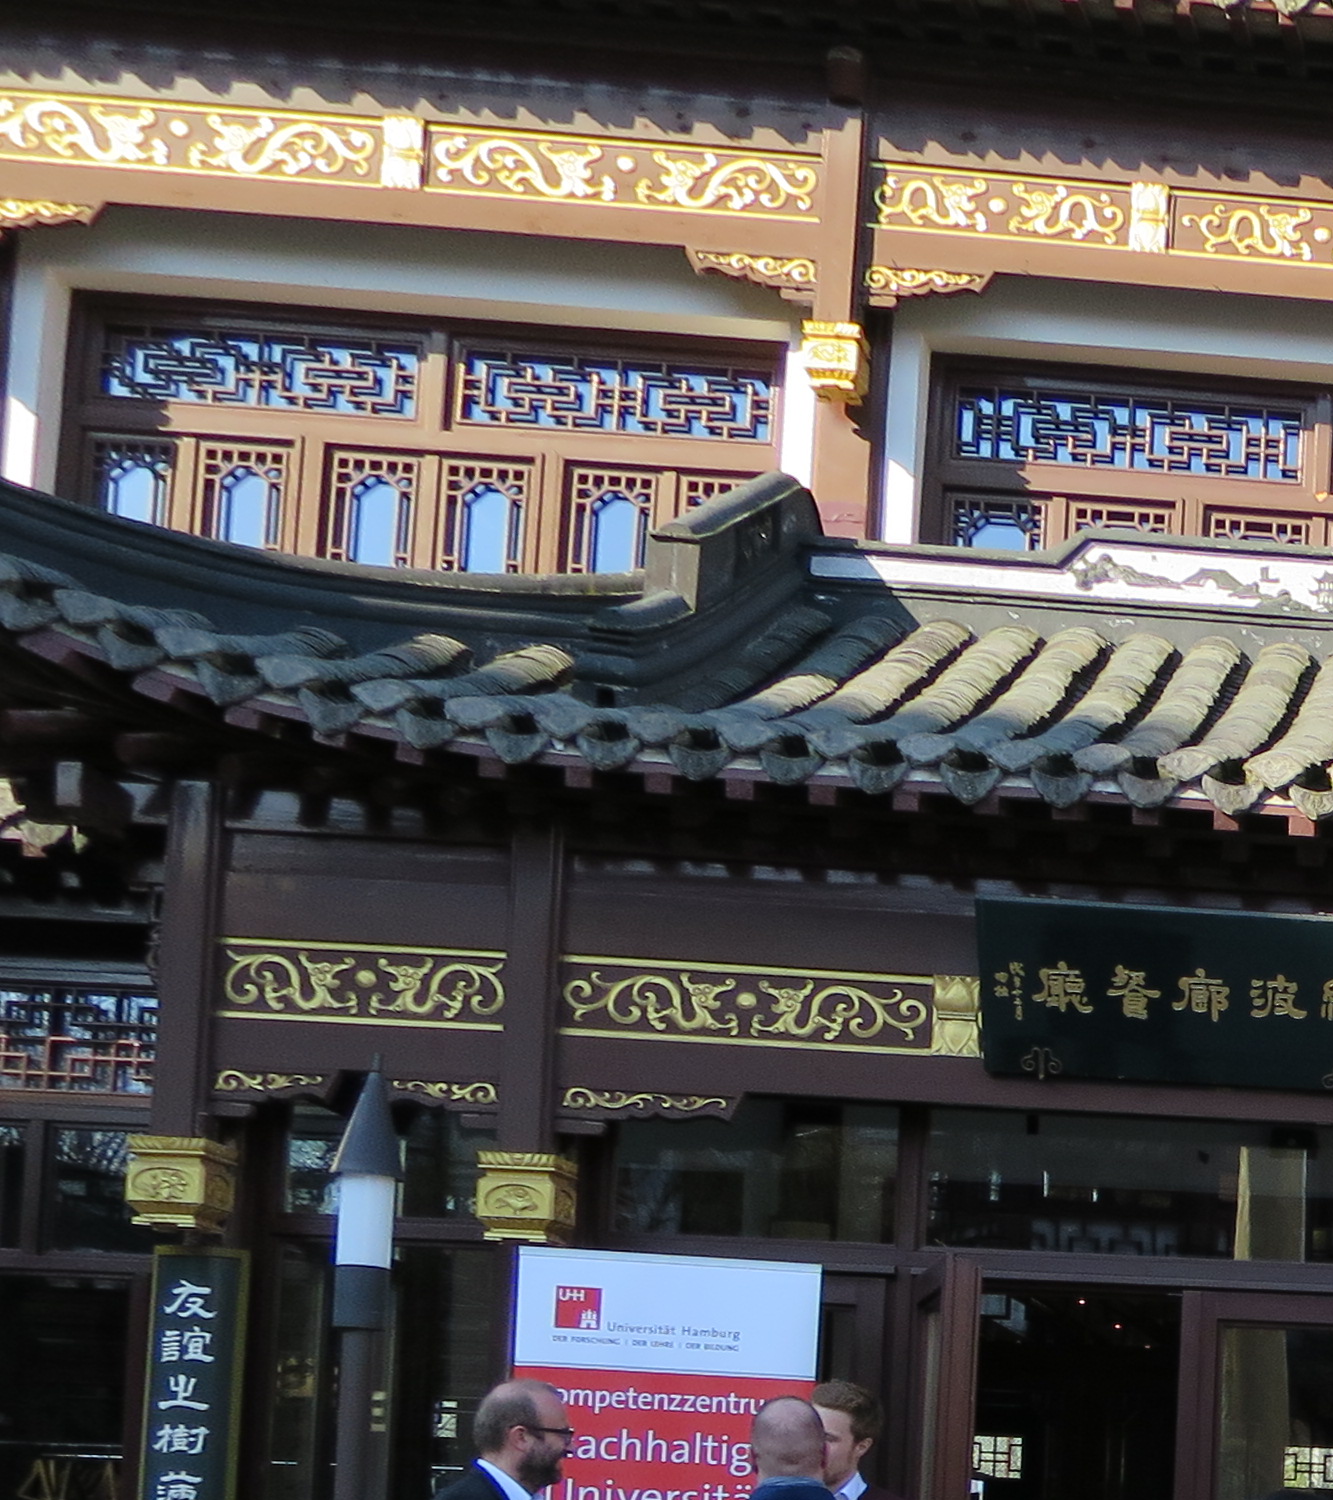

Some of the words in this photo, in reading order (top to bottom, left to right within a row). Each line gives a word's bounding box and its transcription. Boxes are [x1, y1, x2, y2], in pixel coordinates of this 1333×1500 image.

[606, 1321, 676, 1337] Universität
[681, 1325, 741, 1342] Hamburg
[552, 1335, 568, 1343] DER
[570, 1336, 621, 1346] FORSCHUNG
[632, 1339, 647, 1347] DER
[685, 1342, 701, 1350] DER
[557, 1386, 765, 1416] ompetenzzentru
